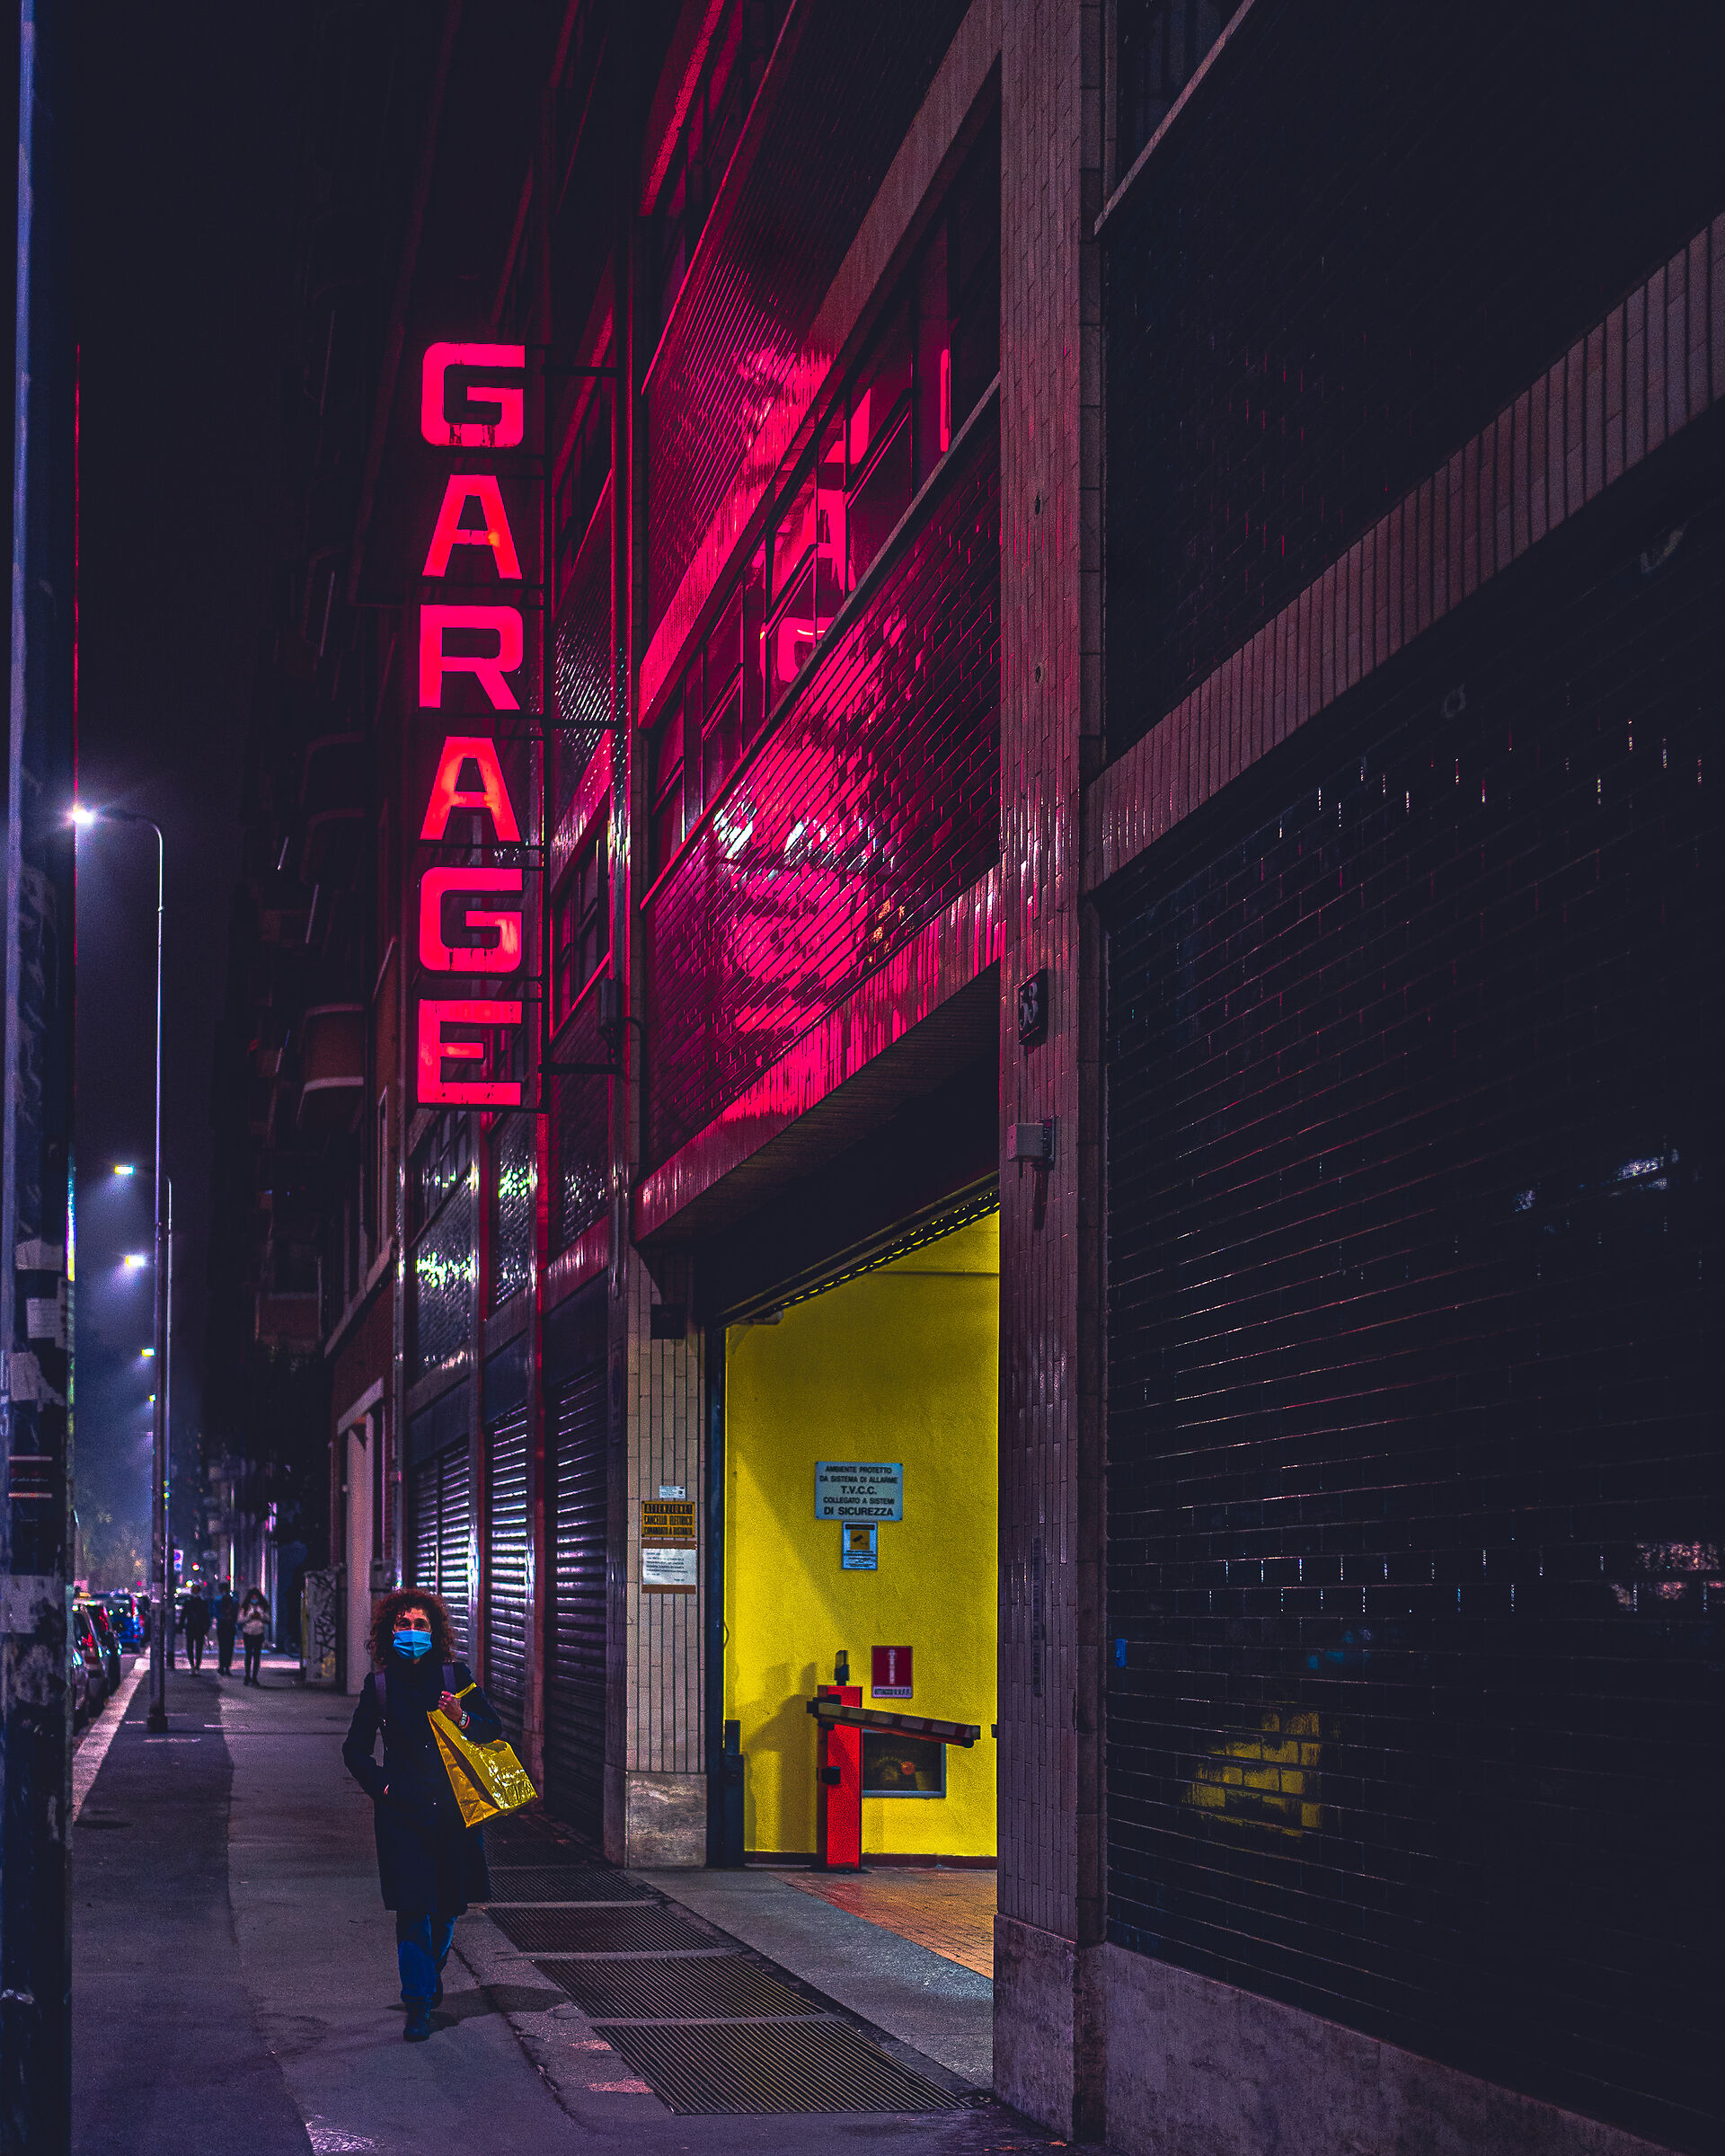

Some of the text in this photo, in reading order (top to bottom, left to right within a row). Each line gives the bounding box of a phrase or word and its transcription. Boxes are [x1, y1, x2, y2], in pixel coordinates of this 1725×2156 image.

[416, 341, 527, 1106] GARAGE
[869, 1476, 898, 1484] ALLARME
[840, 1485, 877, 1494] T.V.C.C.
[823, 1496, 860, 1504] COLLEGATO
[869, 1497, 895, 1505] SISTEMI
[824, 1507, 893, 1516] DI SICUREZZA
